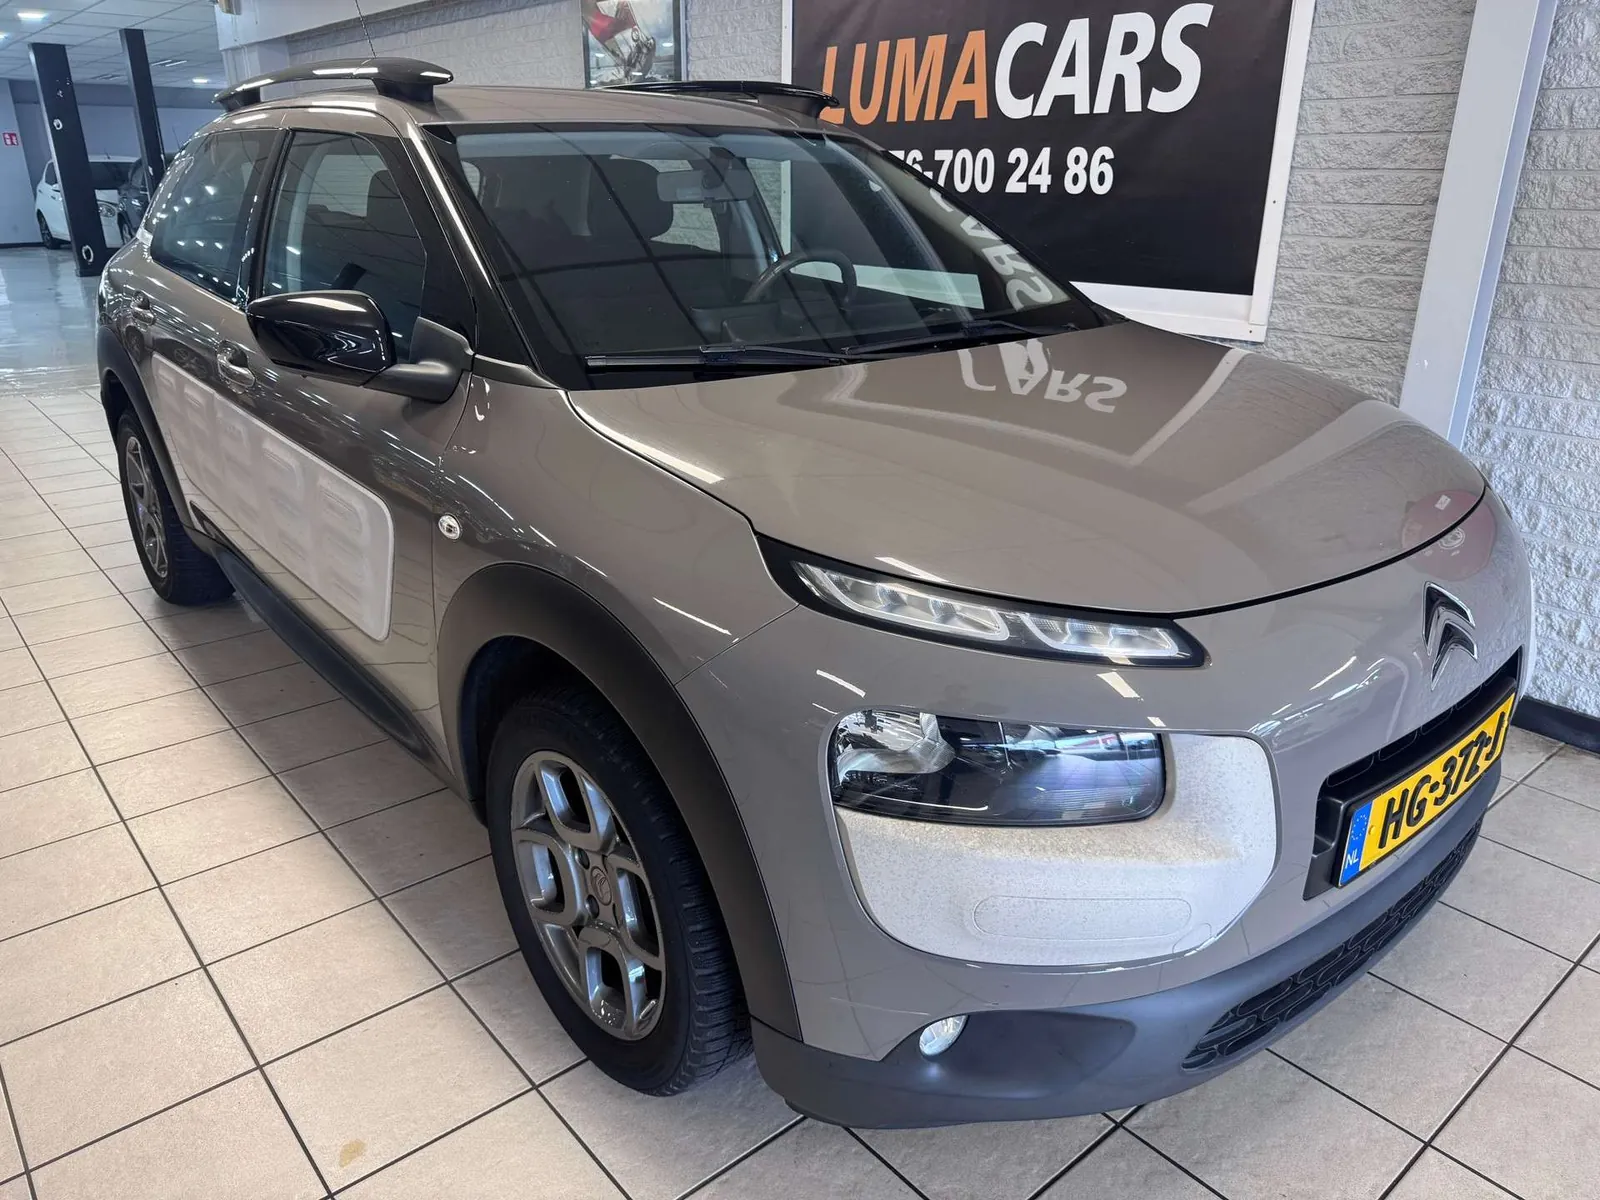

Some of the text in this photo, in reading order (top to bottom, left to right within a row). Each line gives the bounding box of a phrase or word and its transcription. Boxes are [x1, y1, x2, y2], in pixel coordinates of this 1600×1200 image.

[819, 3, 1214, 125] LUMACARS
[1004, 147, 1052, 194] 24
[1063, 146, 1115, 195] 86
[1378, 711, 1506, 849] HG-372-J
[1345, 848, 1359, 869] NL
